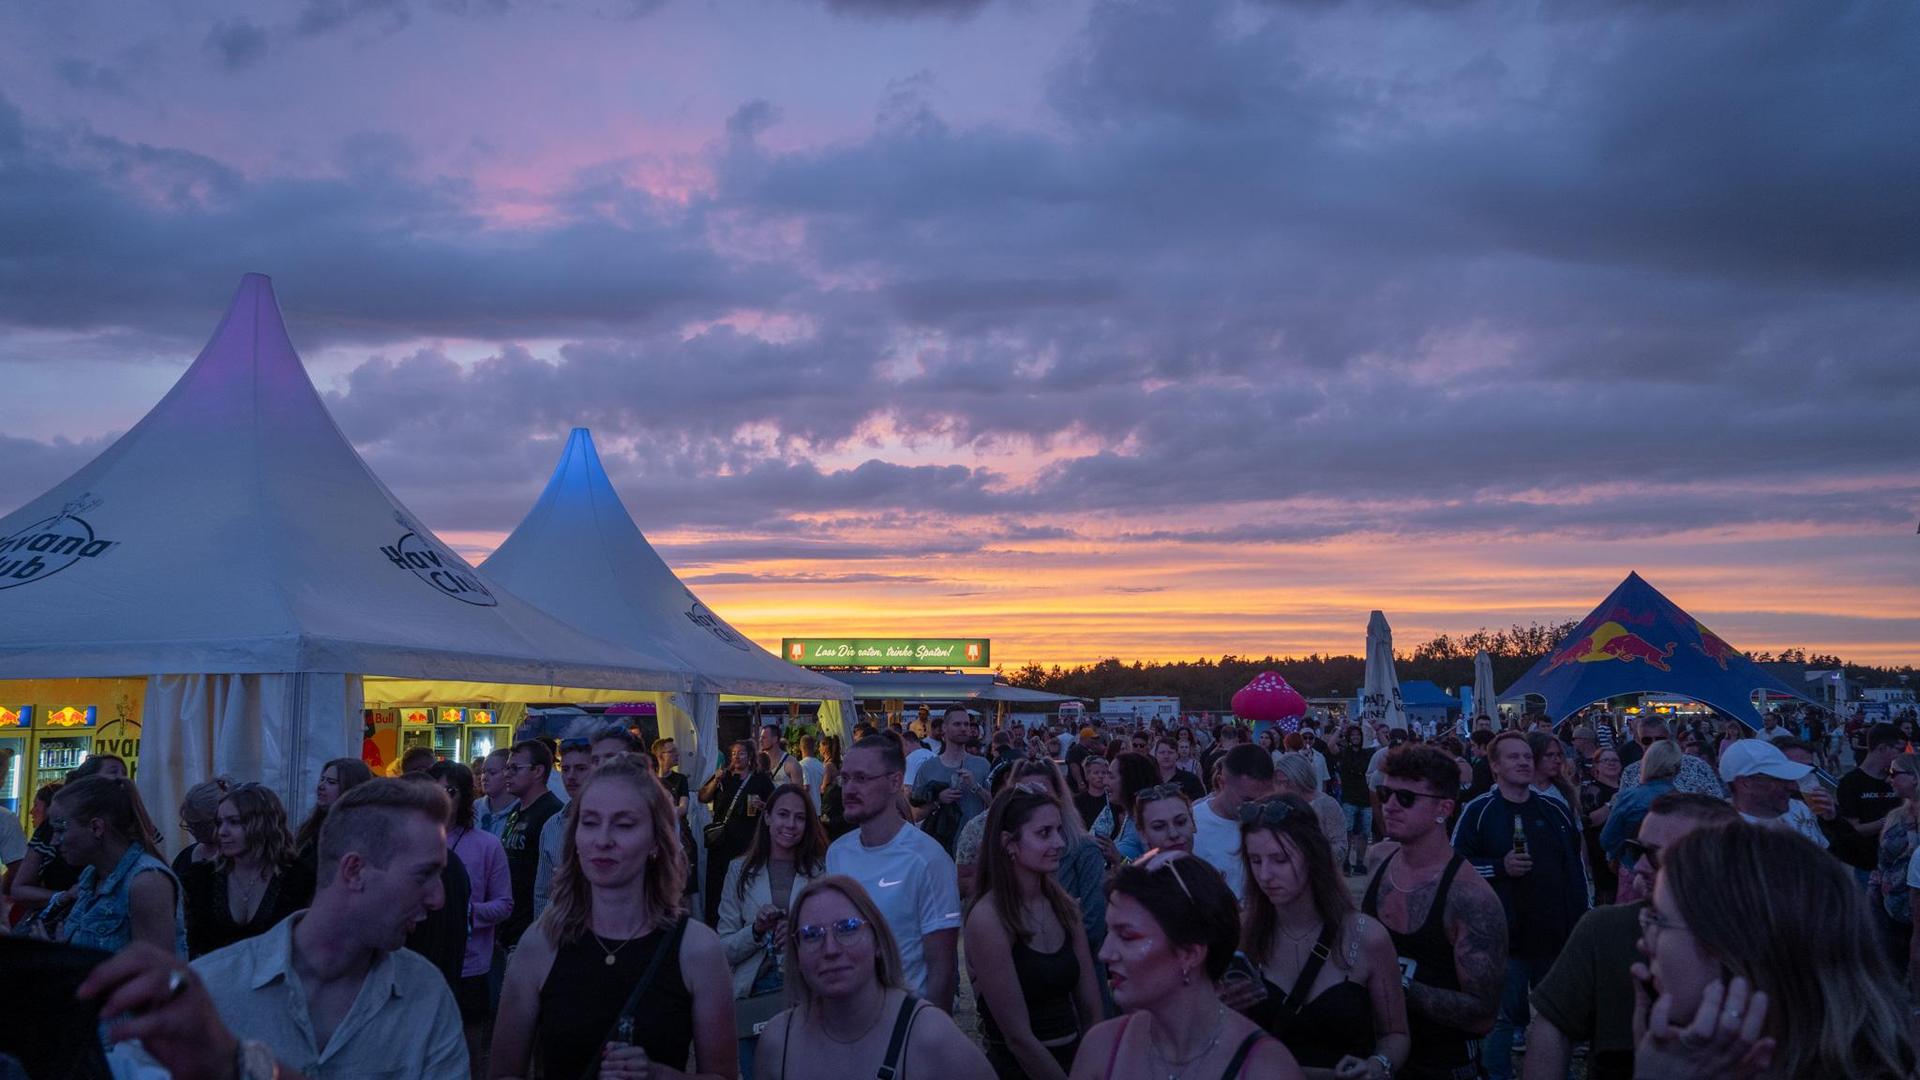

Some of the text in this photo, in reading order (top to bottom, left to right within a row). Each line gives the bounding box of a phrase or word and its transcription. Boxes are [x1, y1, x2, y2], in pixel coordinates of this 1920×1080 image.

[815, 645, 837, 656] Lass
[838, 645, 856, 657] Dir
[886, 645, 913, 657] trinke
[915, 645, 955, 660] Spaten!
[375, 712, 394, 723] Bull
